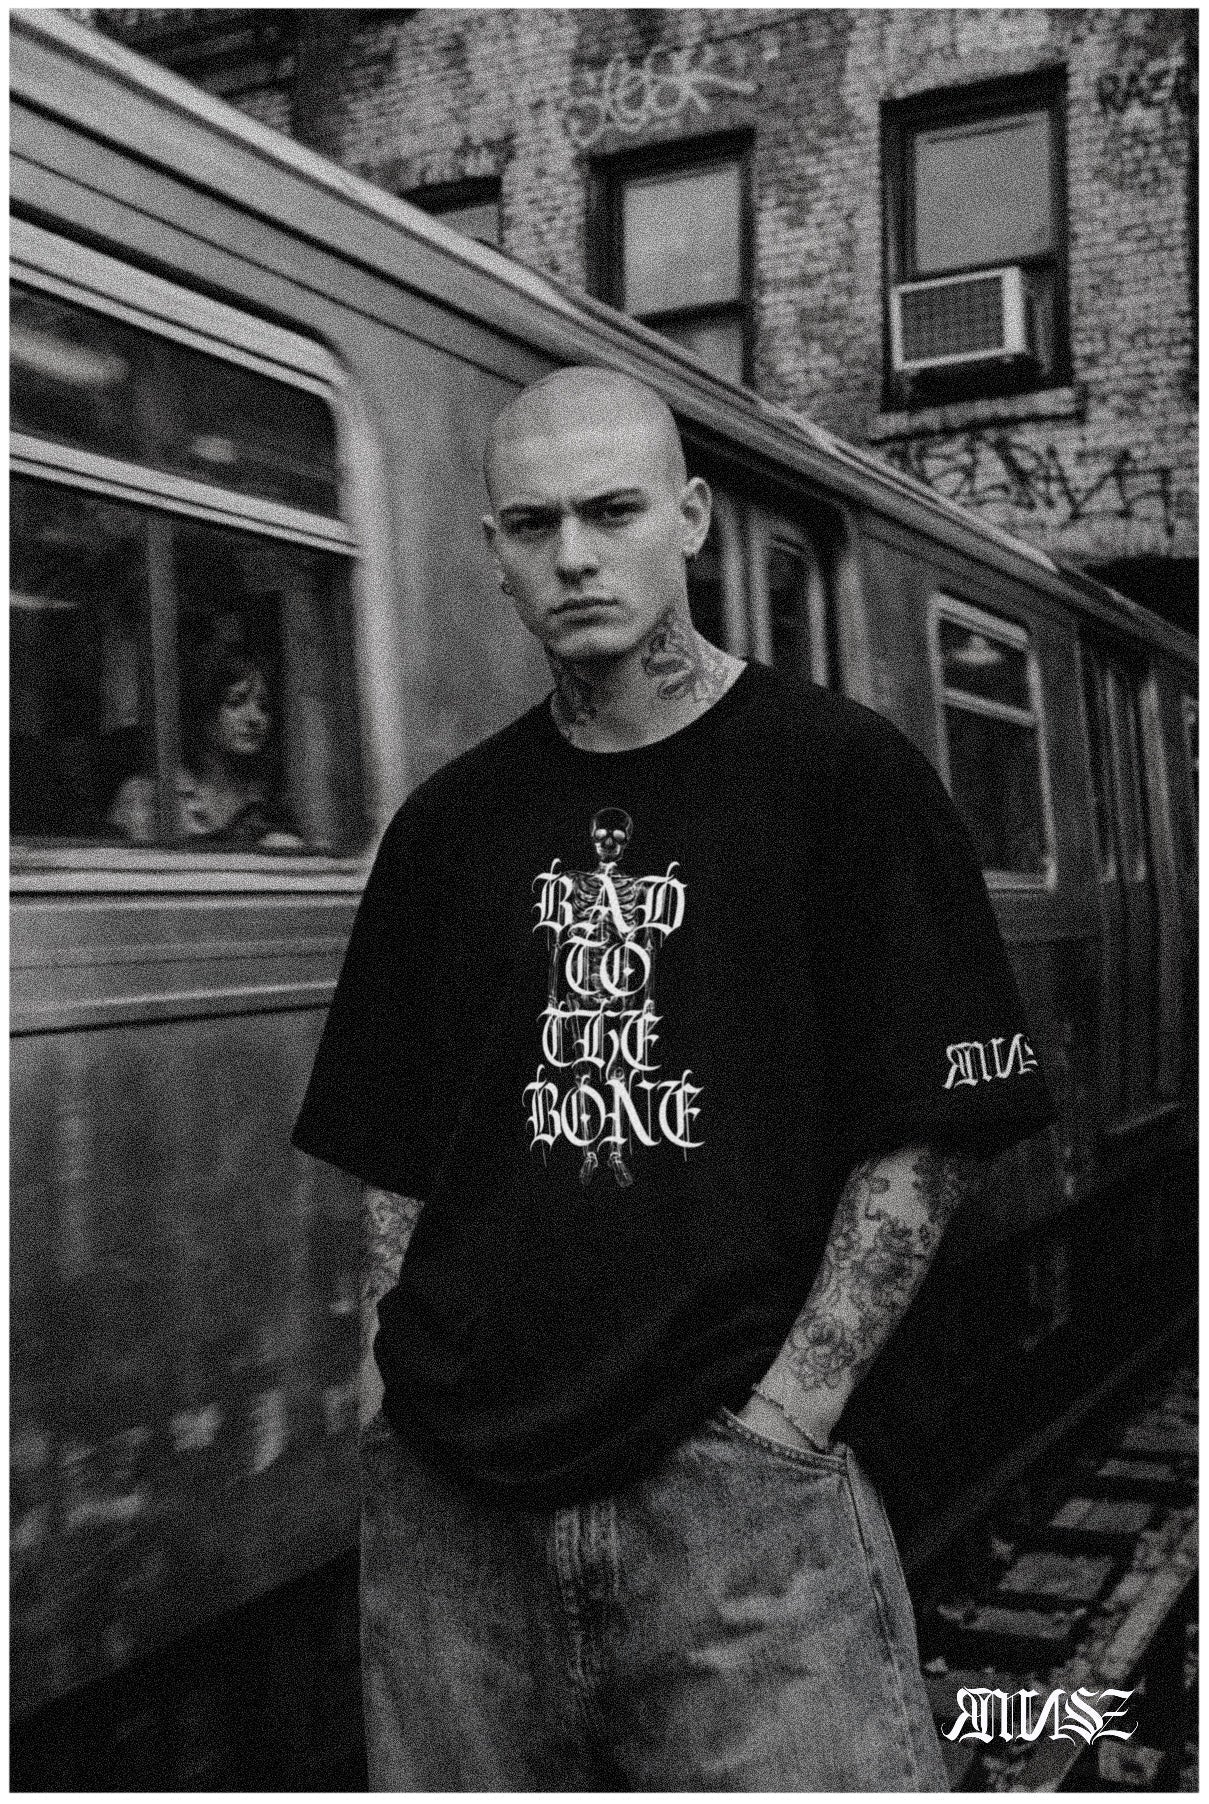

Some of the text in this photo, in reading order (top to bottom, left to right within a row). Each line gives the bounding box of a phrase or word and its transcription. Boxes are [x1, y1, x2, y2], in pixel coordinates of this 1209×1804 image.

[532, 858, 687, 937] BAD
[560, 922, 651, 997] TO
[536, 1000, 663, 1081] THE
[522, 1064, 705, 1150] BONE
